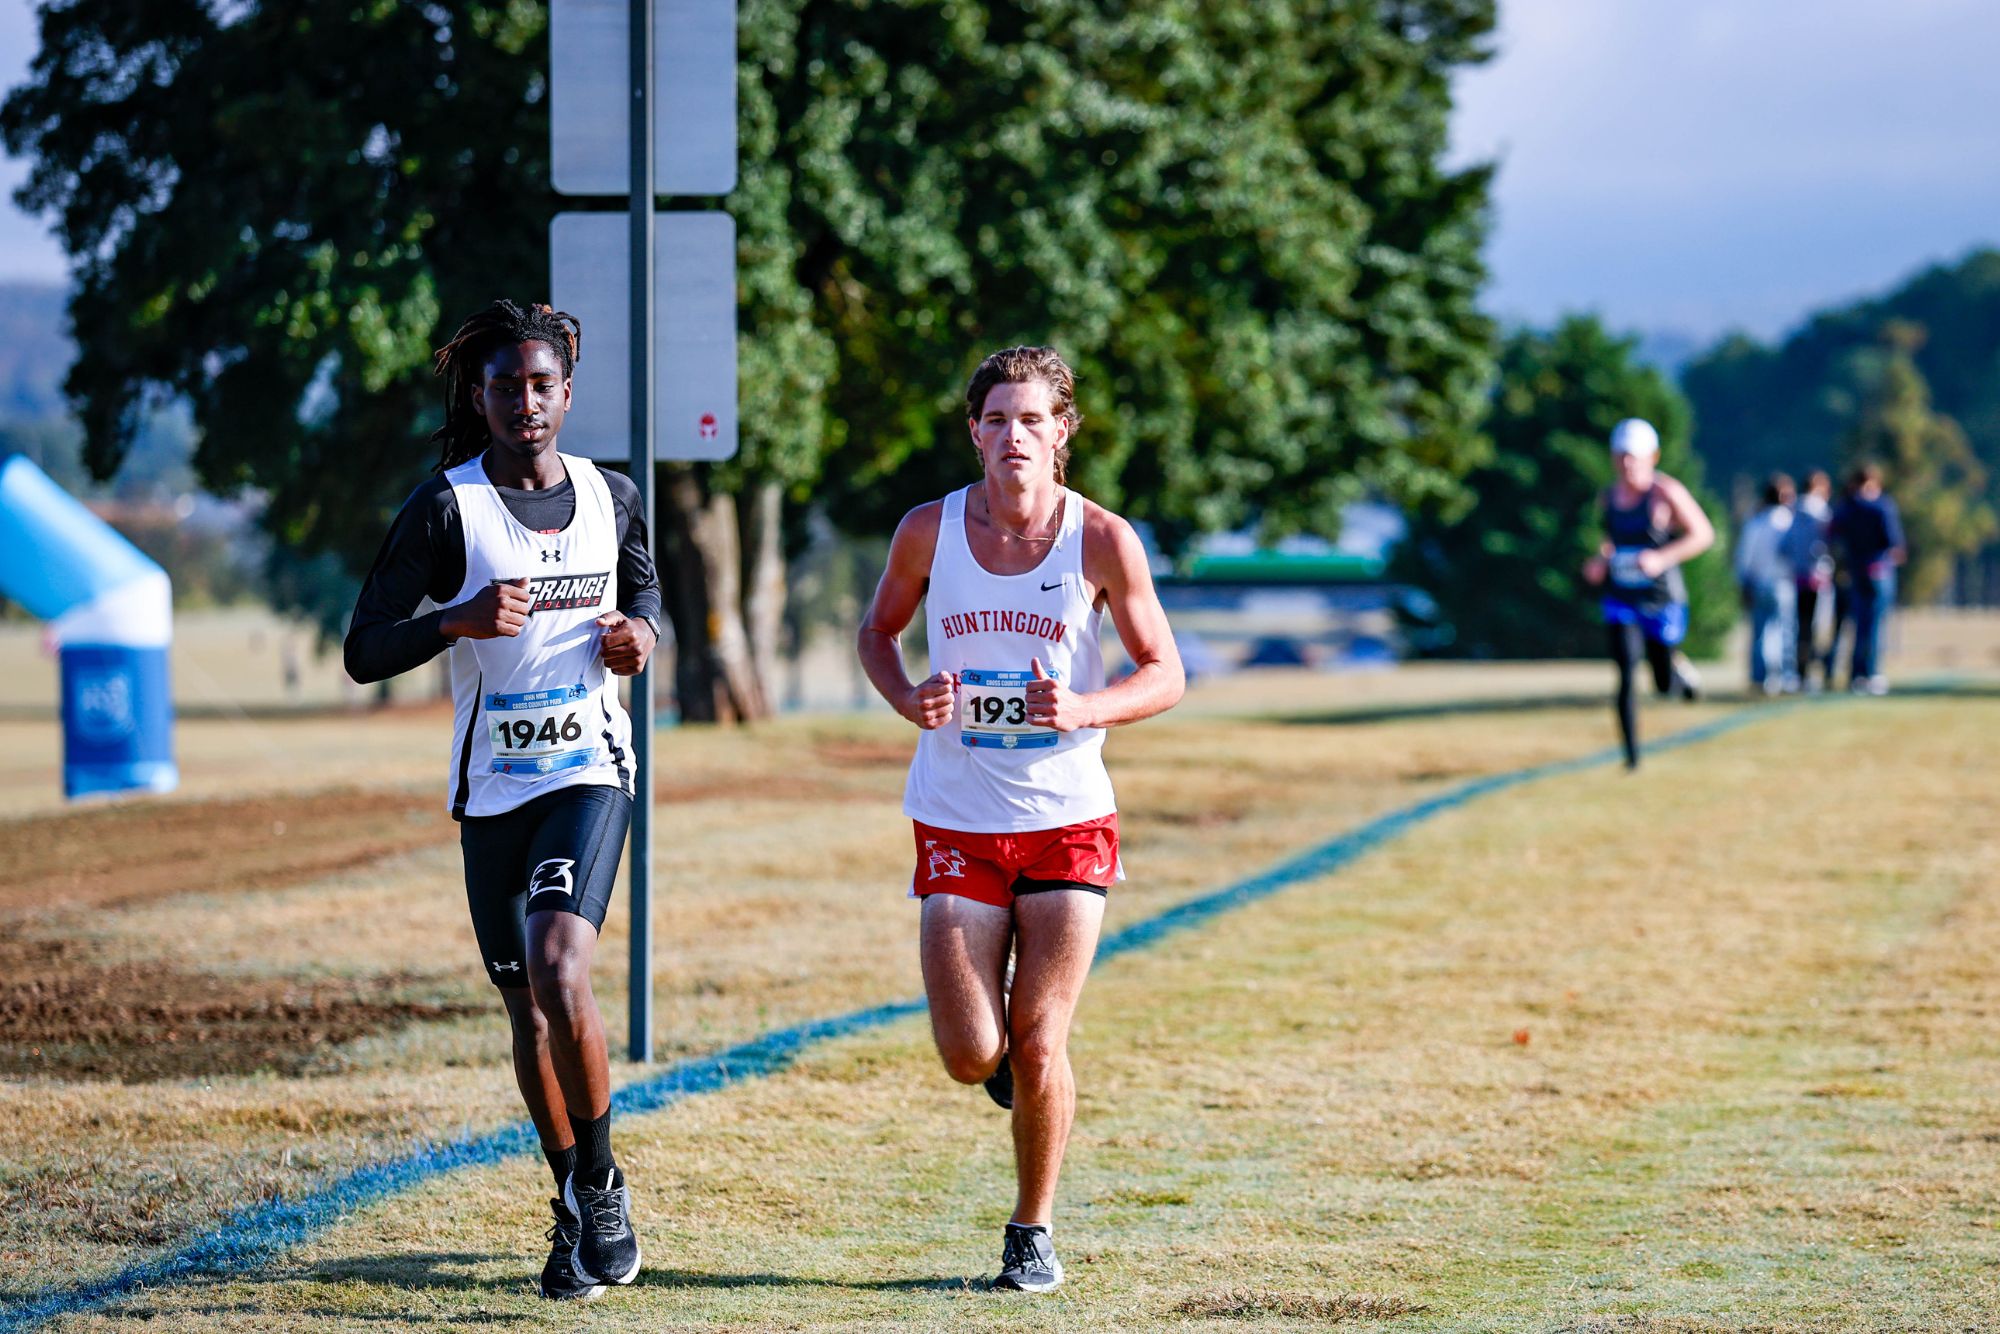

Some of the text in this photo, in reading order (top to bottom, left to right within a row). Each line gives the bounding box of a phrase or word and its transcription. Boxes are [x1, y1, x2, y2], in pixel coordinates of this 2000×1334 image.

[528, 576, 607, 602] GRANGE
[534, 597, 600, 610] COLLEGE
[941, 610, 1066, 643] HUNTINGDON
[970, 696, 1026, 725] 193
[498, 712, 582, 749] 1946
